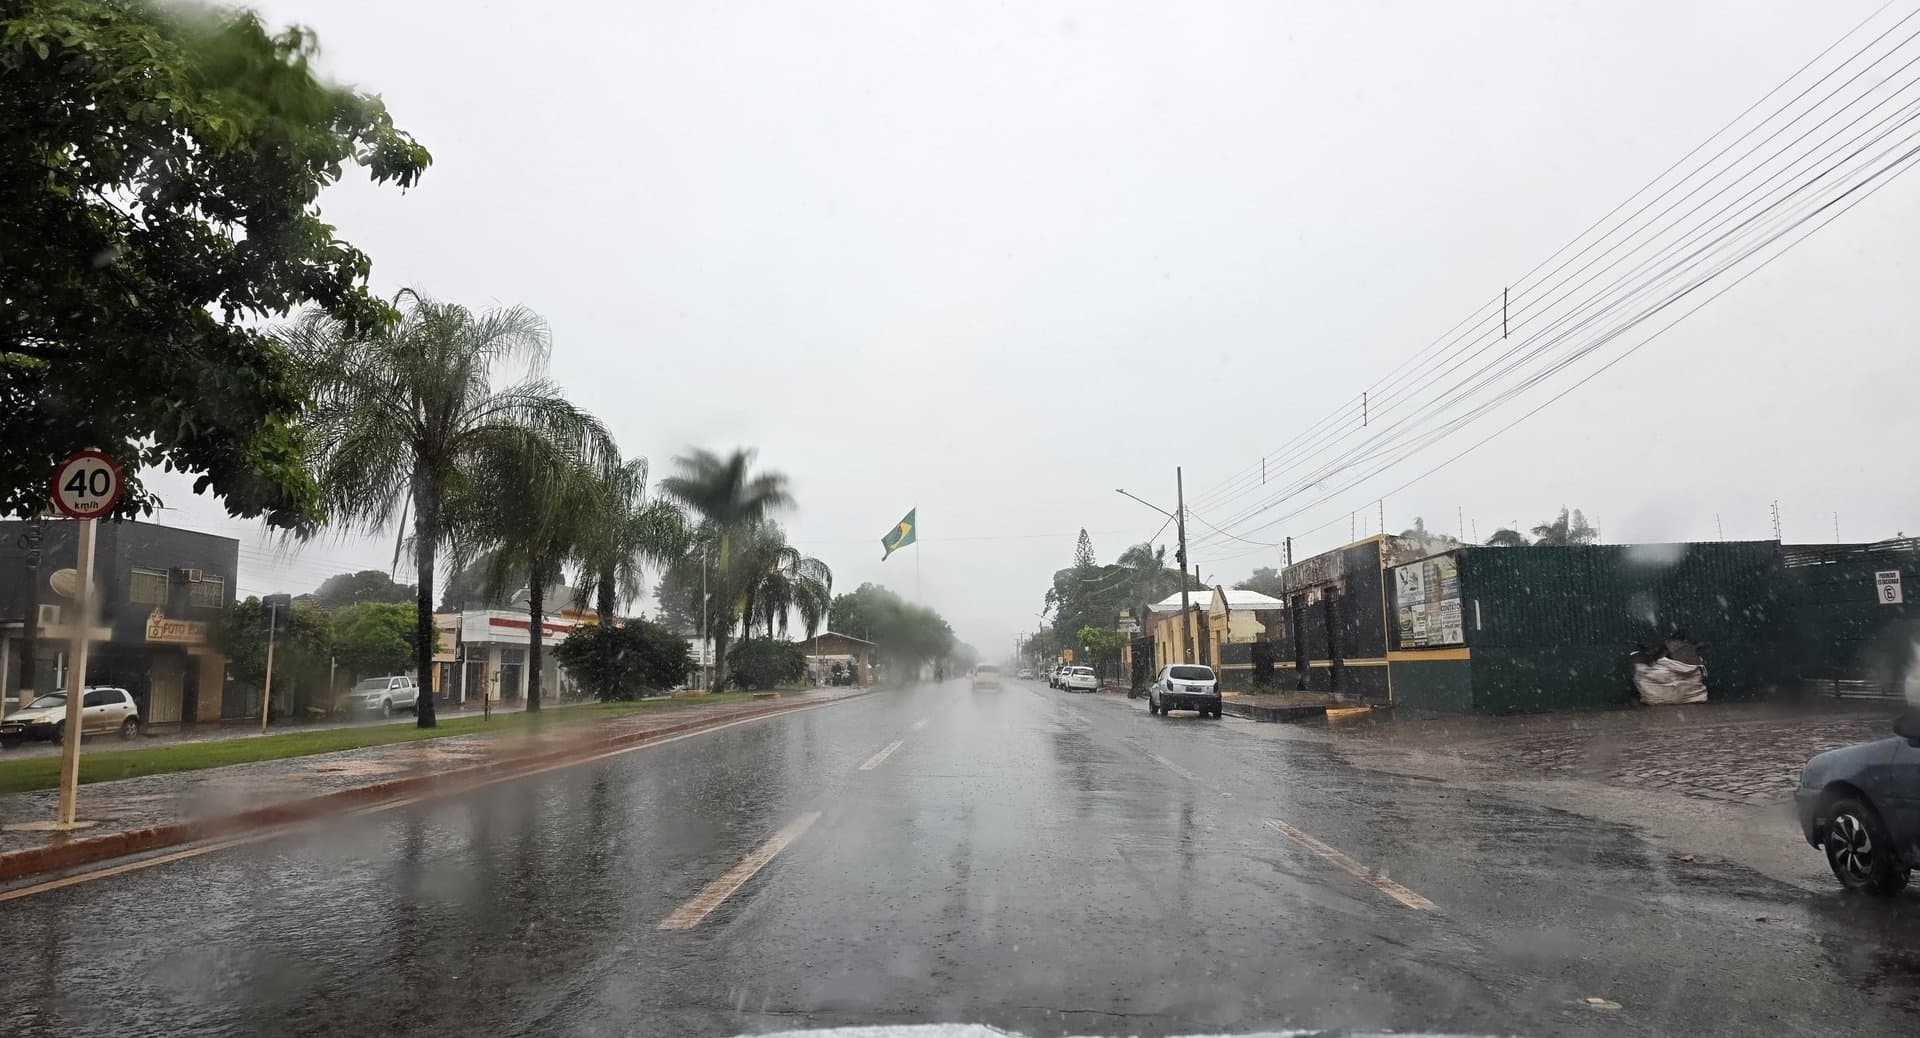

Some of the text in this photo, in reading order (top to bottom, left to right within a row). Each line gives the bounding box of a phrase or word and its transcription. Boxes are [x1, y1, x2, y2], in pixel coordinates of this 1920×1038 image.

[64, 468, 110, 497] 40
[74, 501, 99, 510] km/h
[163, 623, 185, 634] FOTO
